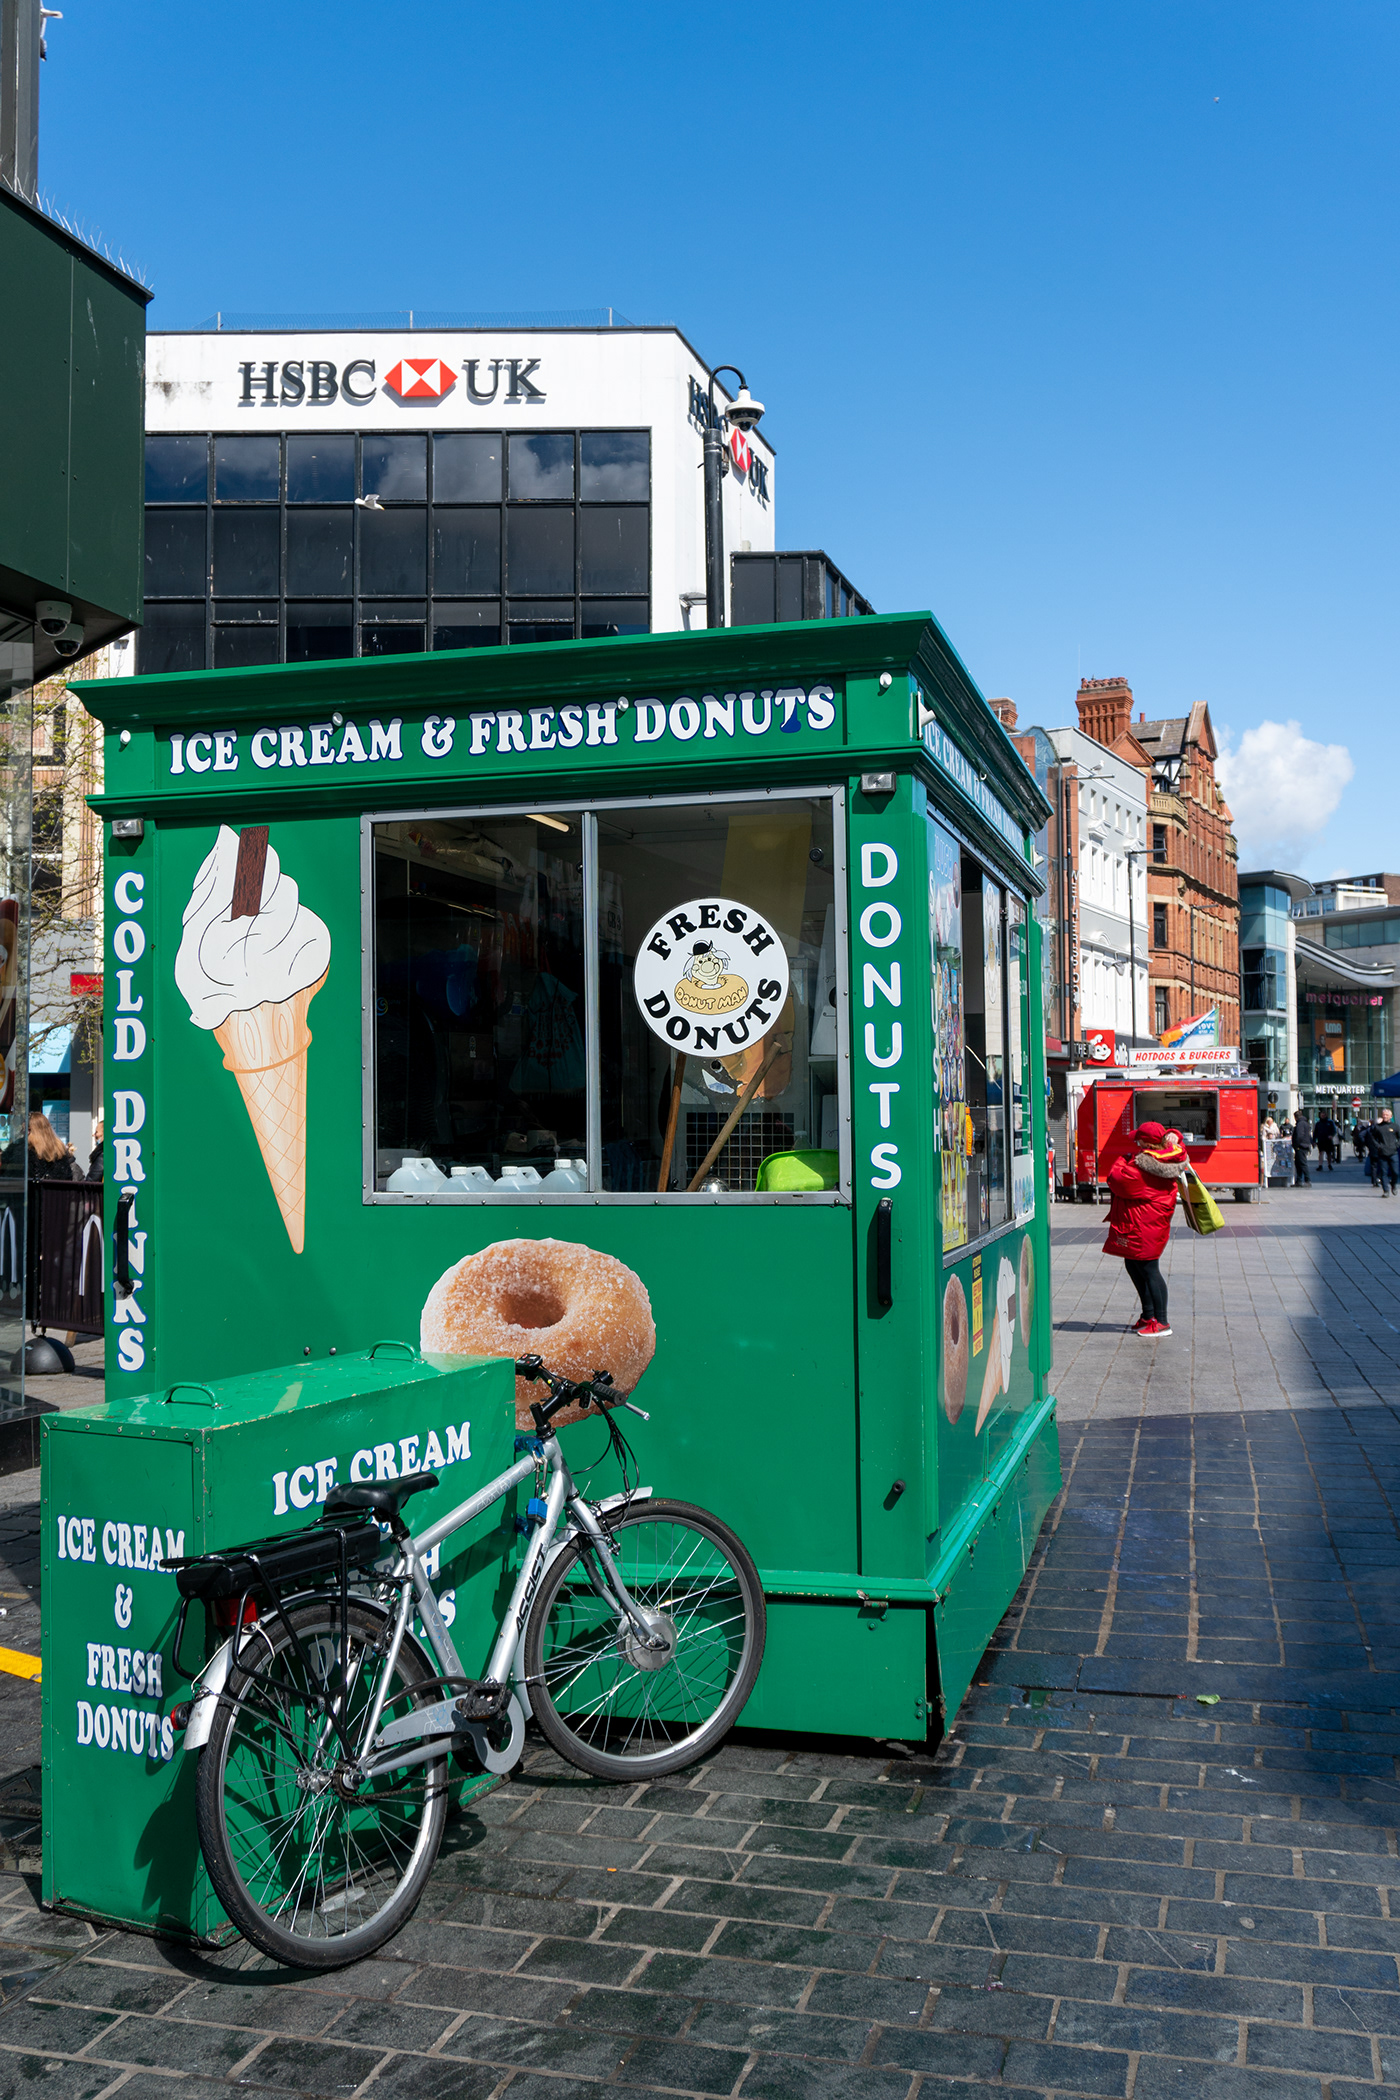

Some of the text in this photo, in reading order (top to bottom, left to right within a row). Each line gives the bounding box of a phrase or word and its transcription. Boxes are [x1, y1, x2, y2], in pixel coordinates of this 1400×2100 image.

[240, 359, 546, 401] HSBC UK
[170, 685, 836, 775] ICE CREAM & FRESH DONUTS
[925, 720, 941, 761] ICE
[943, 736, 973, 796] CREAM
[981, 785, 1002, 830] FRESH
[647, 904, 775, 961] FRESH
[643, 978, 782, 1050] DONUTS
[675, 986, 748, 1010] DONUT MAN
[860, 842, 903, 1190] DONUTS
[1306, 992, 1384, 1007] metquarter
[1135, 1050, 1231, 1062] HOTDOGS & BURGERS
[1324, 1023, 1342, 1033] LMA
[1315, 1085, 1366, 1095] METQUARTER
[112, 871, 149, 1373] COLD DRINKS
[273, 1420, 472, 1516] ICE CREAM
[57, 1514, 187, 1573] ICE CREAM
[114, 1583, 133, 1629] &
[515, 1542, 549, 1641] ASSIST
[85, 1642, 164, 1699] FRESH
[76, 1700, 174, 1762] DONUTS
